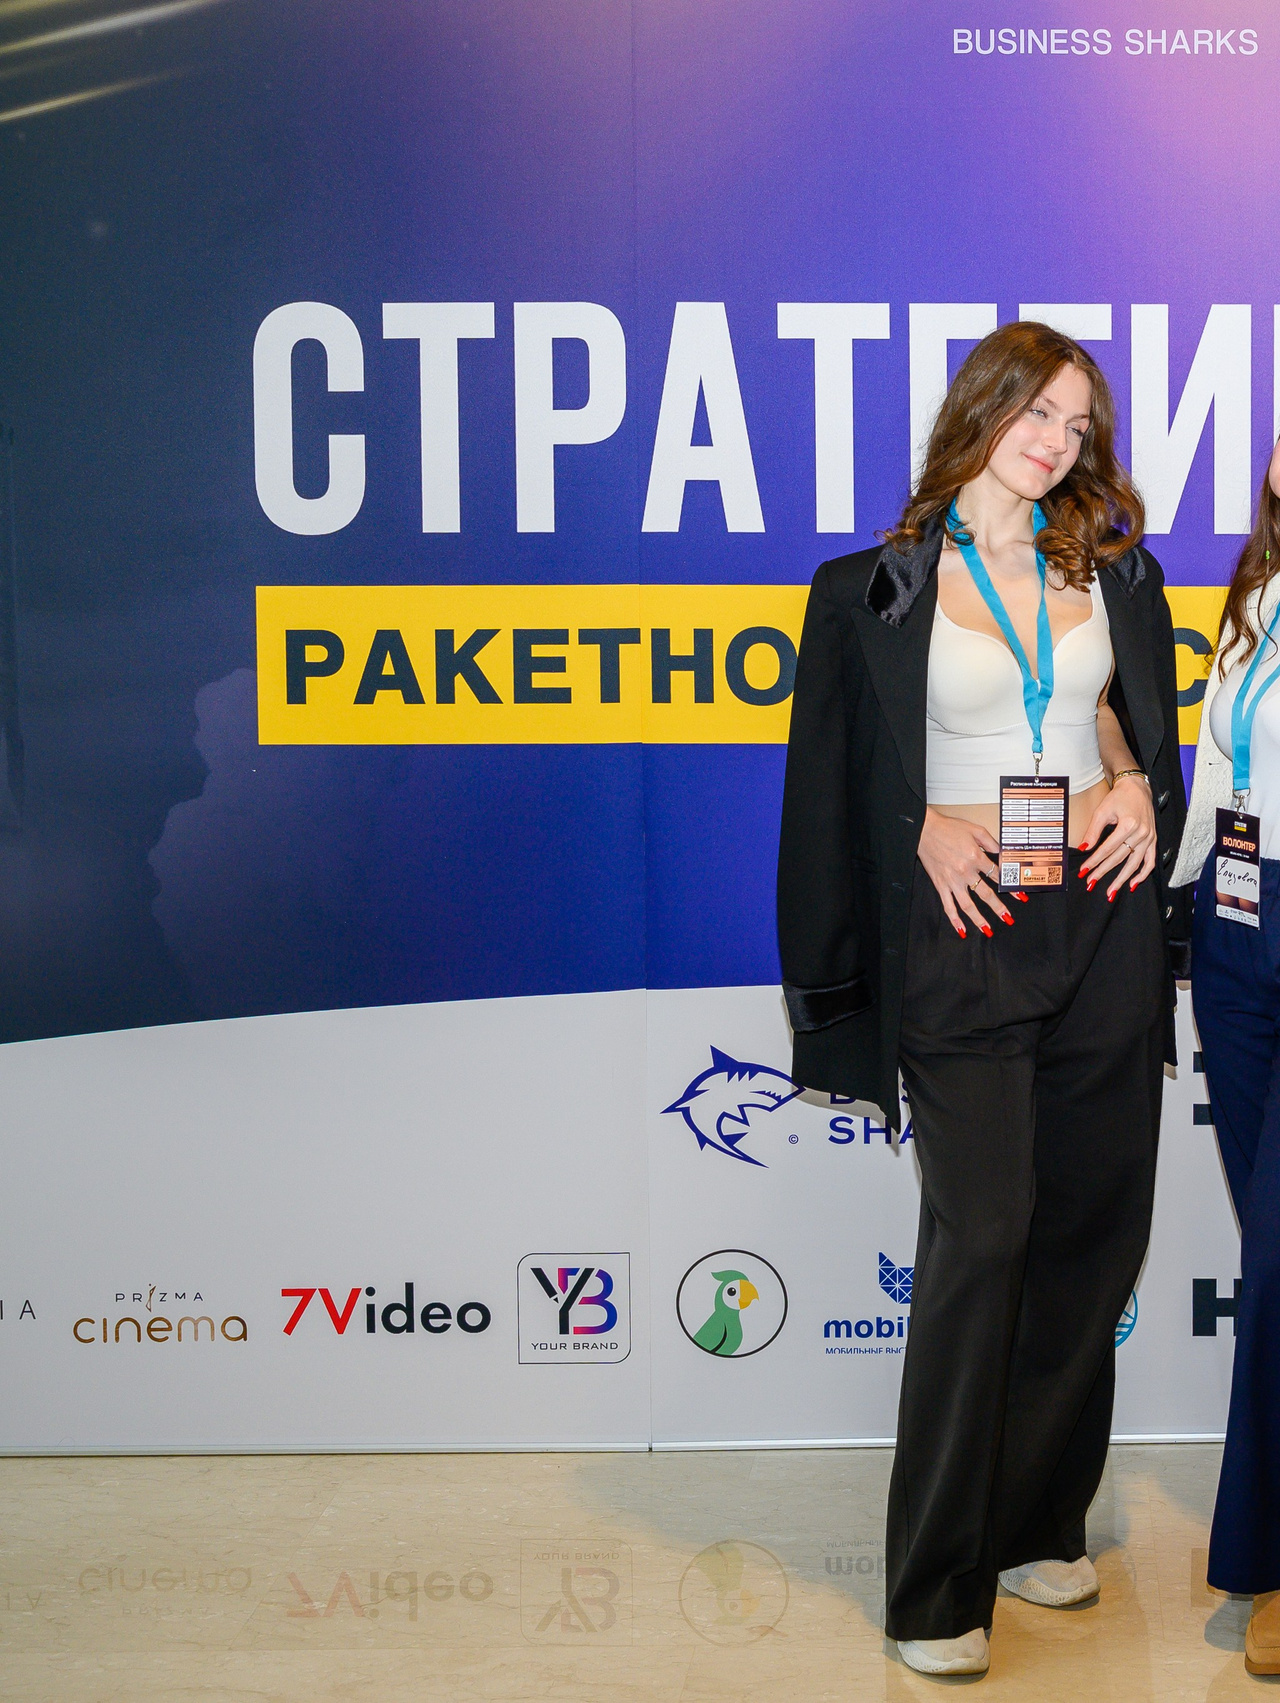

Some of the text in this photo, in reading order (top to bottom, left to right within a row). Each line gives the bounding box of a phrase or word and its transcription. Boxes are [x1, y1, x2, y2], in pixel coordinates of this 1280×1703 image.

[953, 28, 1259, 56] BUSINESS SHARKS
[1222, 836, 1256, 853] ВОЛОНТЕР
[115, 1283, 204, 1312] PRIZMA
[281, 1282, 491, 1336] 7Video
[73, 1315, 248, 1344] cinema
[531, 1342, 619, 1351] YOUR BRAND
